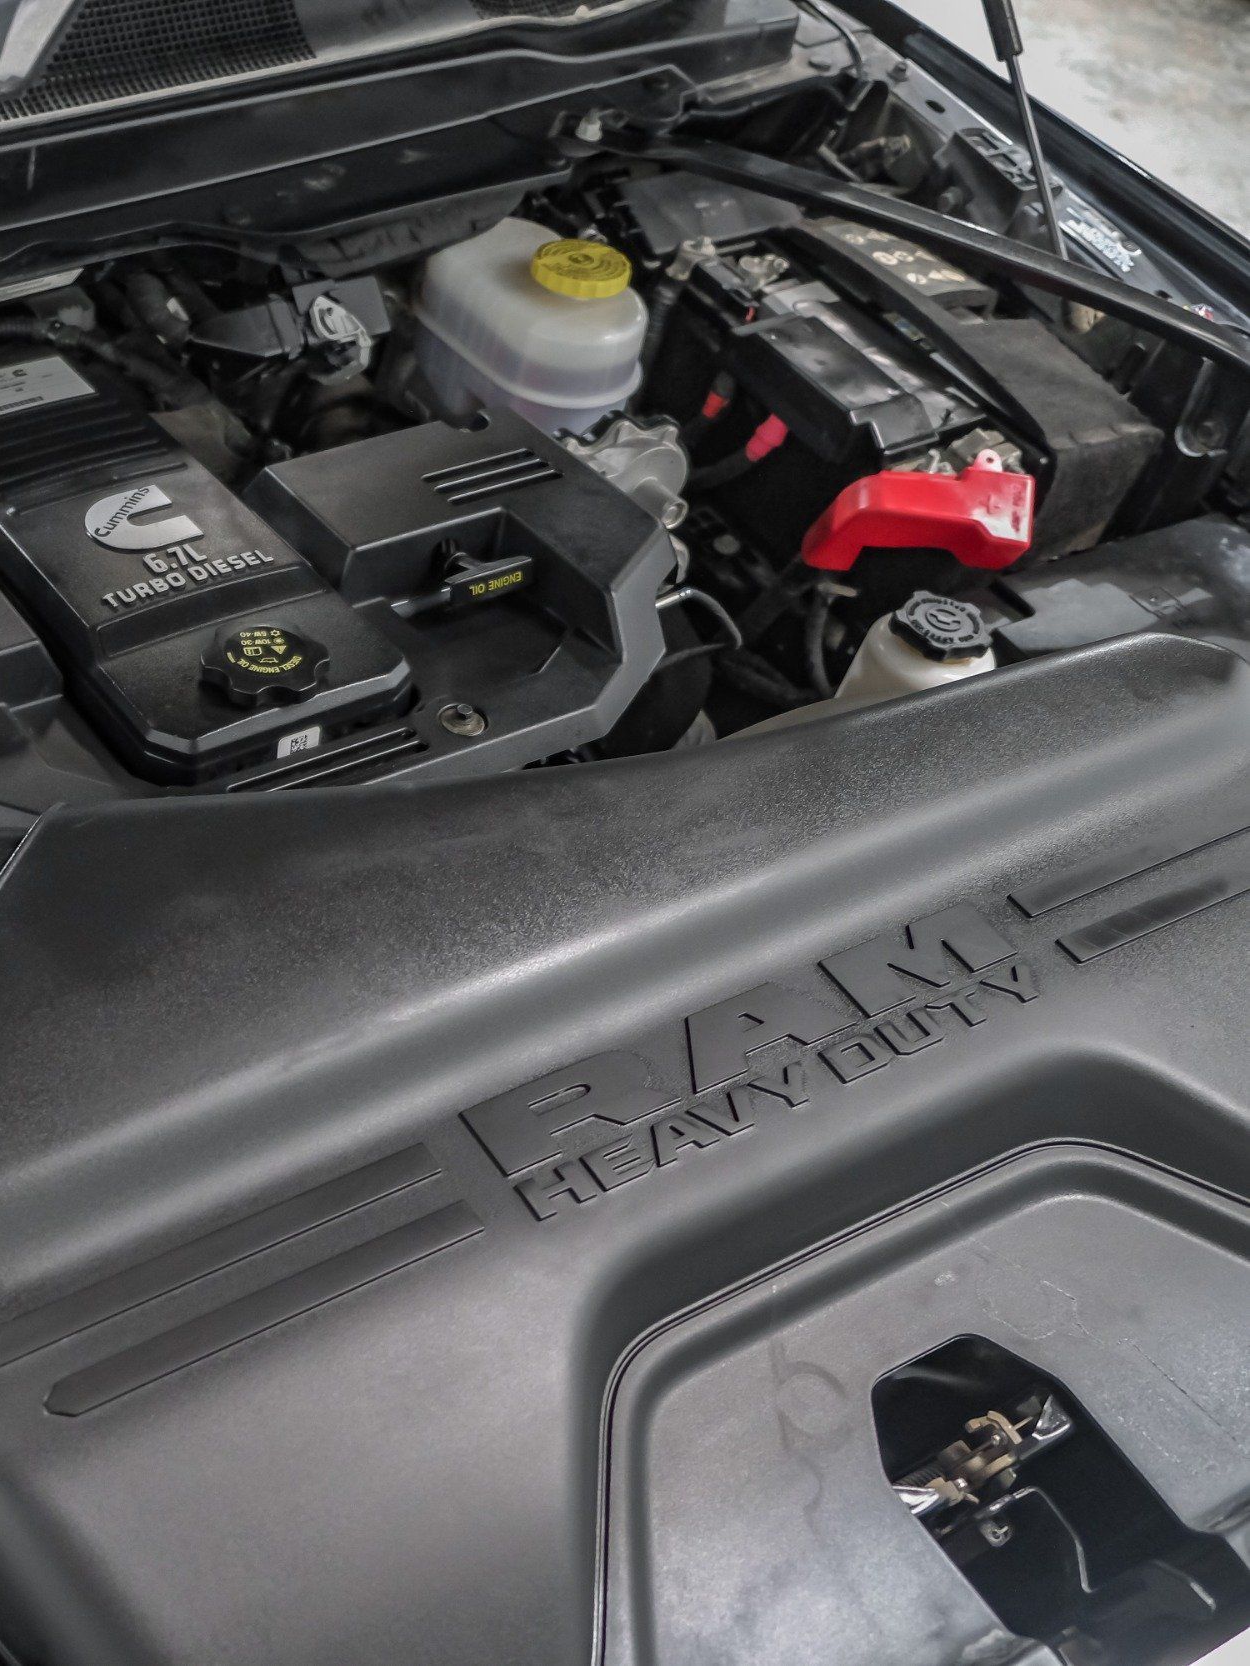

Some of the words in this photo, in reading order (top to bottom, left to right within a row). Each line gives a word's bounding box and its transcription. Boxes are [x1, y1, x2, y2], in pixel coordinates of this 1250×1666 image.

[94, 486, 151, 538] Cummins
[142, 543, 208, 574] 6.7L
[102, 572, 187, 609] TURBO
[187, 550, 275, 582] DIESEL
[469, 584, 485, 595] OIL
[488, 572, 522, 590] ENGINE
[247, 664, 281, 674] ENGINE
[458, 901, 1019, 1177] RAM
[513, 1060, 810, 1221] HEAVY
[817, 962, 1039, 1085] DUTY
